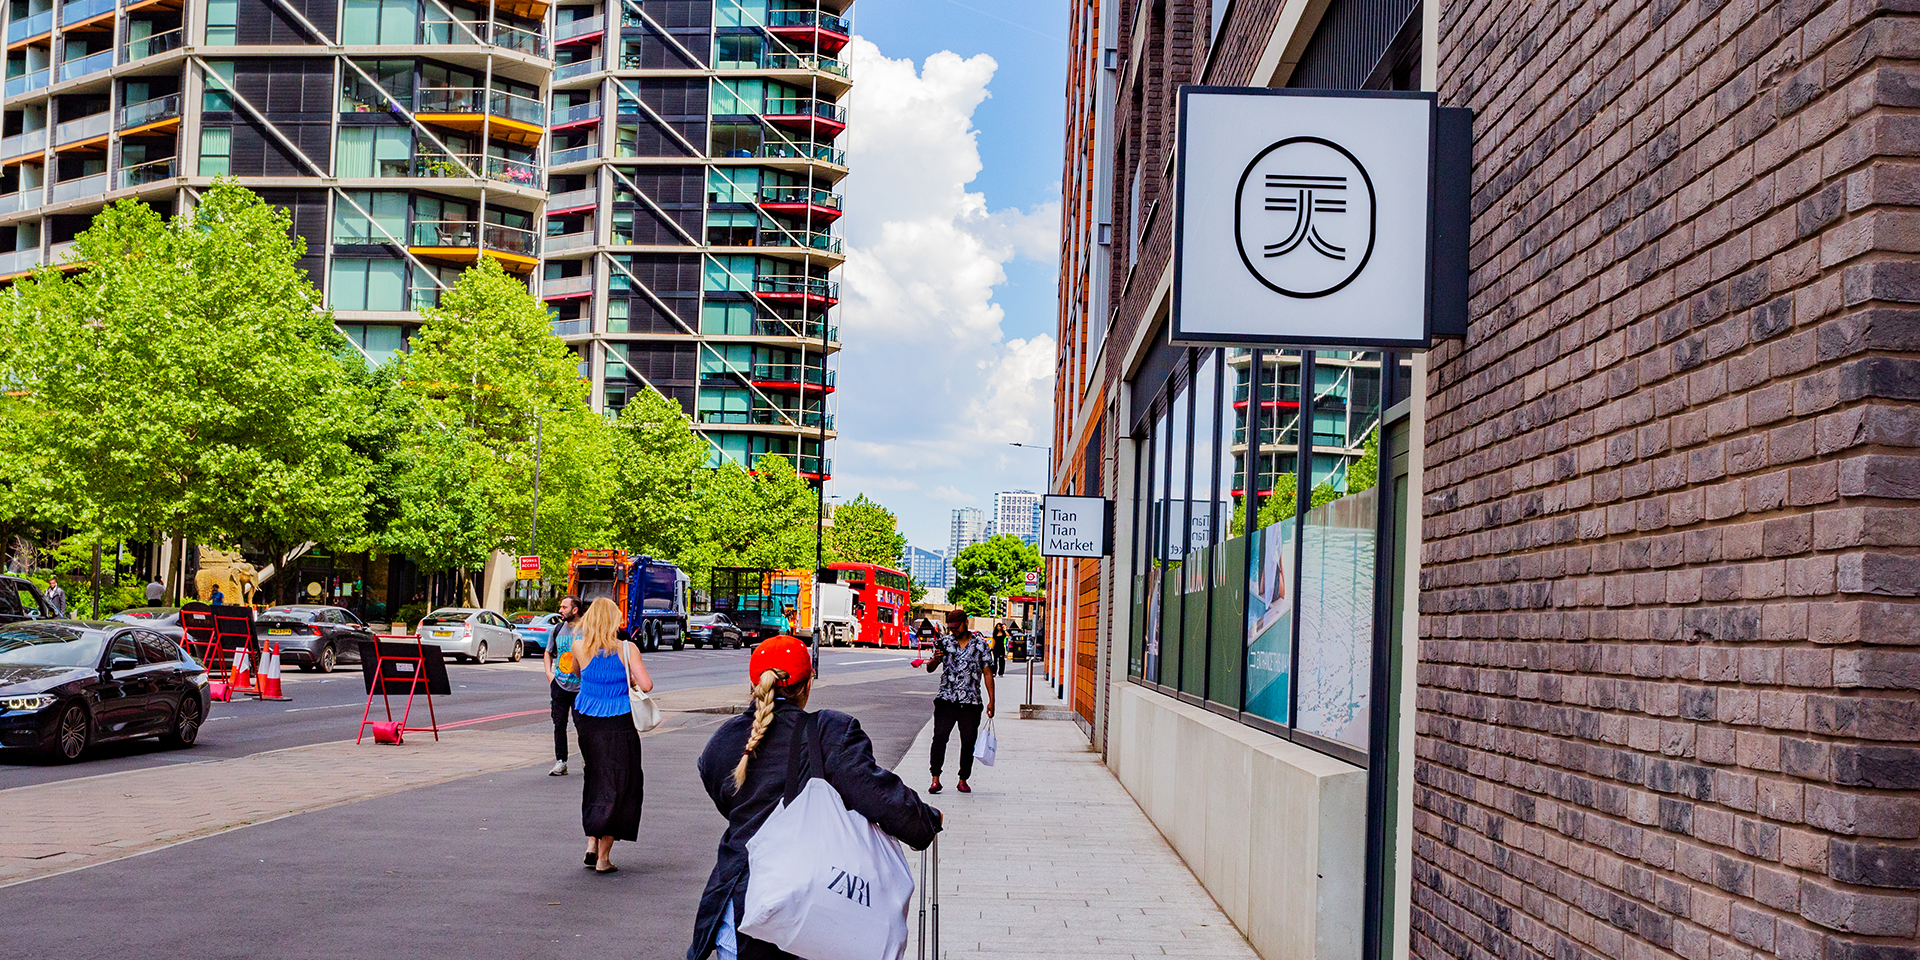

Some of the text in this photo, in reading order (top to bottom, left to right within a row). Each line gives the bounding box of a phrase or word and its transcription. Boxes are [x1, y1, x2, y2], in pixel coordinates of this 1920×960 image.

[1050, 508, 1077, 521] Tian
[1050, 523, 1077, 536] Tian
[1049, 538, 1094, 552] Market
[827, 866, 871, 908] ZARA
